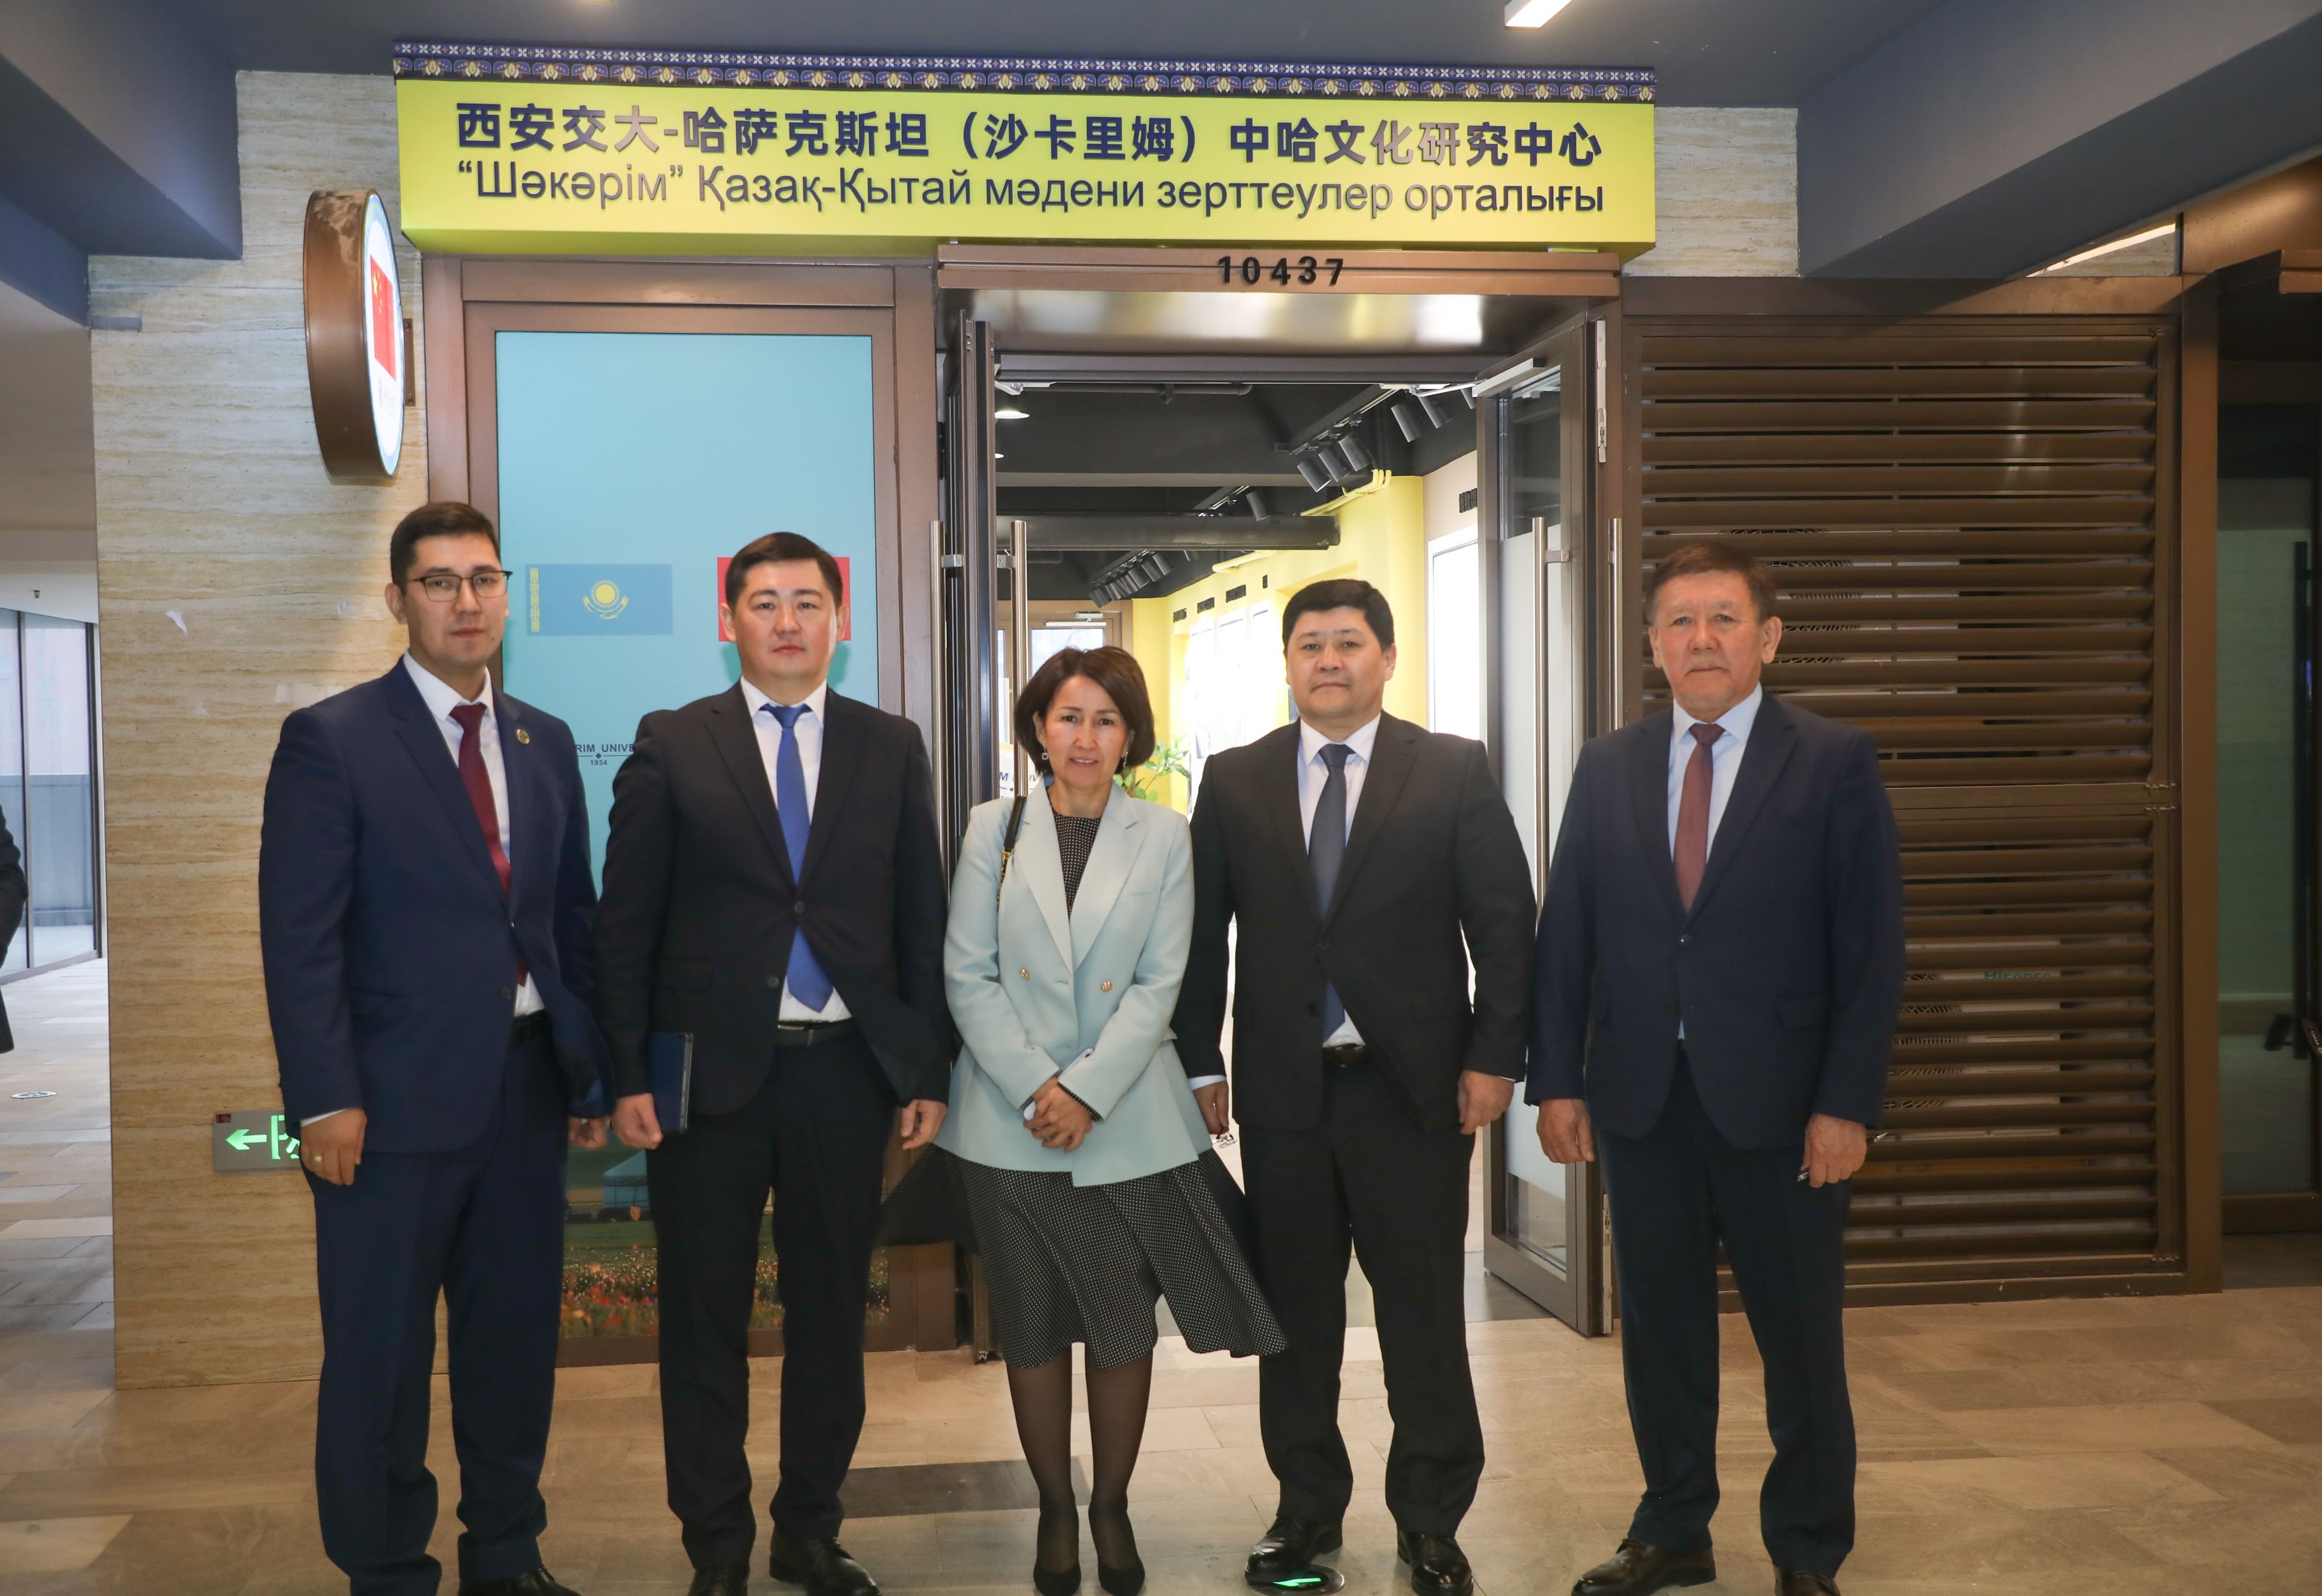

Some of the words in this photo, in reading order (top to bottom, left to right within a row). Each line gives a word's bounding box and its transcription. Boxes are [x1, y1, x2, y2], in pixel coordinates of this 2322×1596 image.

[699, 165, 971, 213] Қазақ-Қытай
[986, 178, 1144, 213] мәдени
[1157, 181, 1393, 219] зерттеулер
[1405, 184, 1603, 220] орталығы
[1217, 256, 1344, 287] 10437
